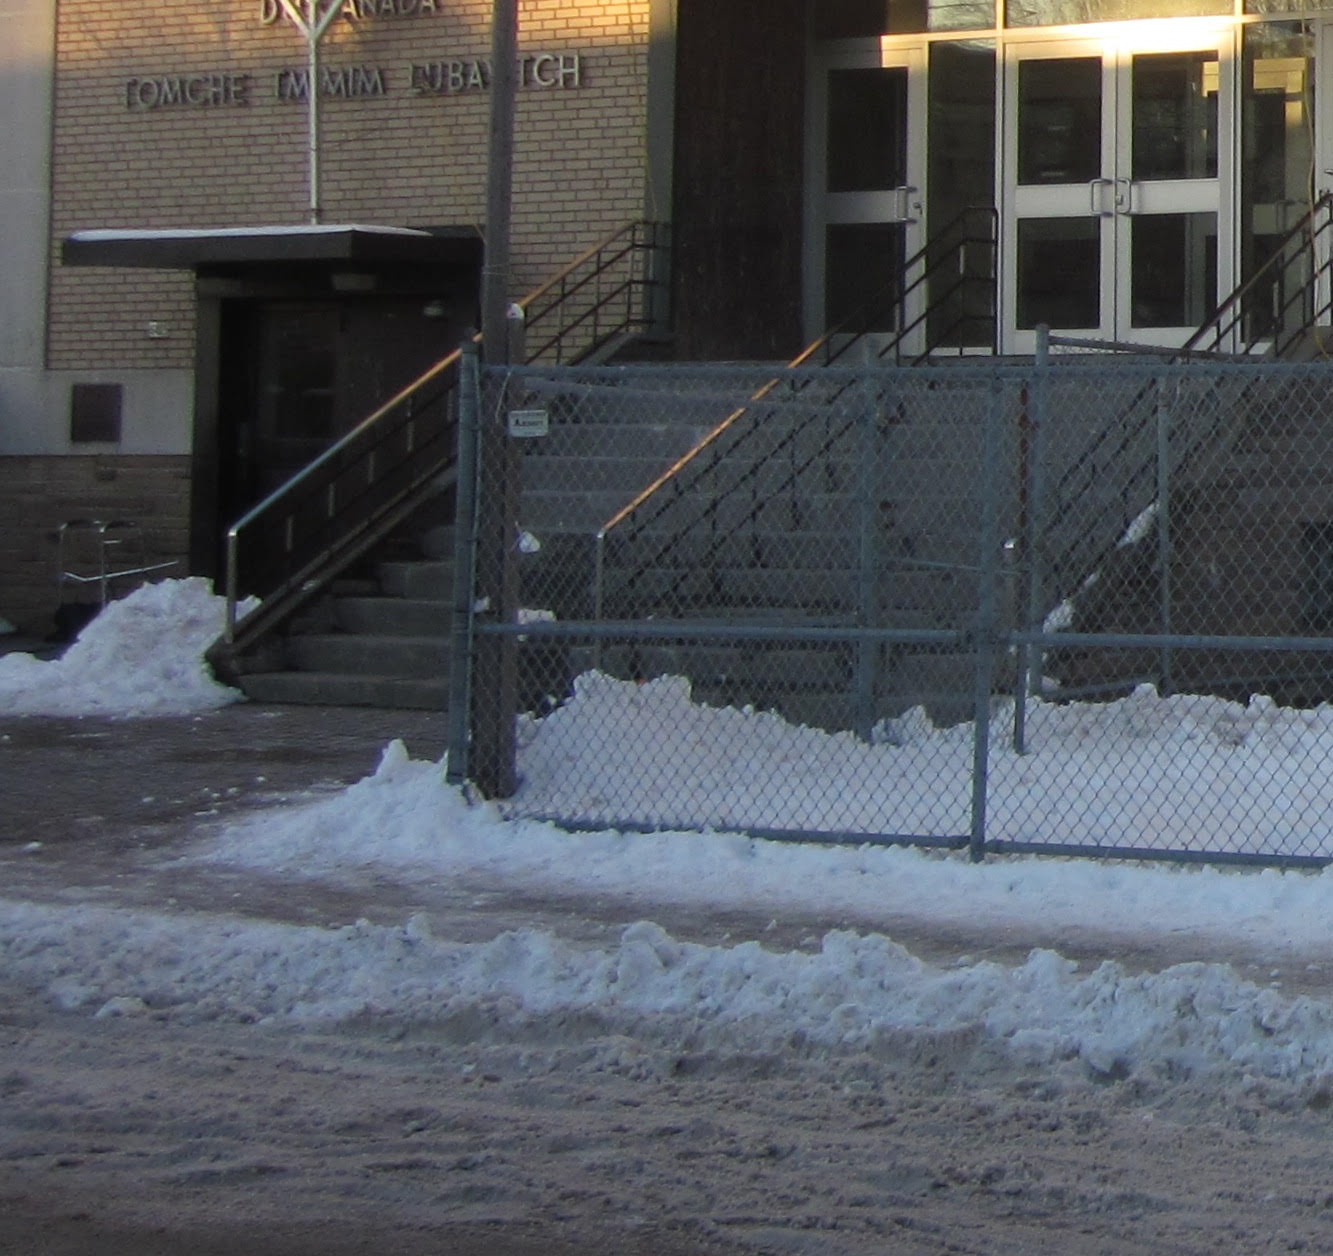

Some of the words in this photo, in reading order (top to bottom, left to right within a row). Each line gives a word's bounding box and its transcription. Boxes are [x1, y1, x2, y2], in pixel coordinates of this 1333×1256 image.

[124, 73, 247, 109] TOMCHE
[274, 65, 386, 100] TMMIM
[408, 54, 581, 96] LUBATCH
